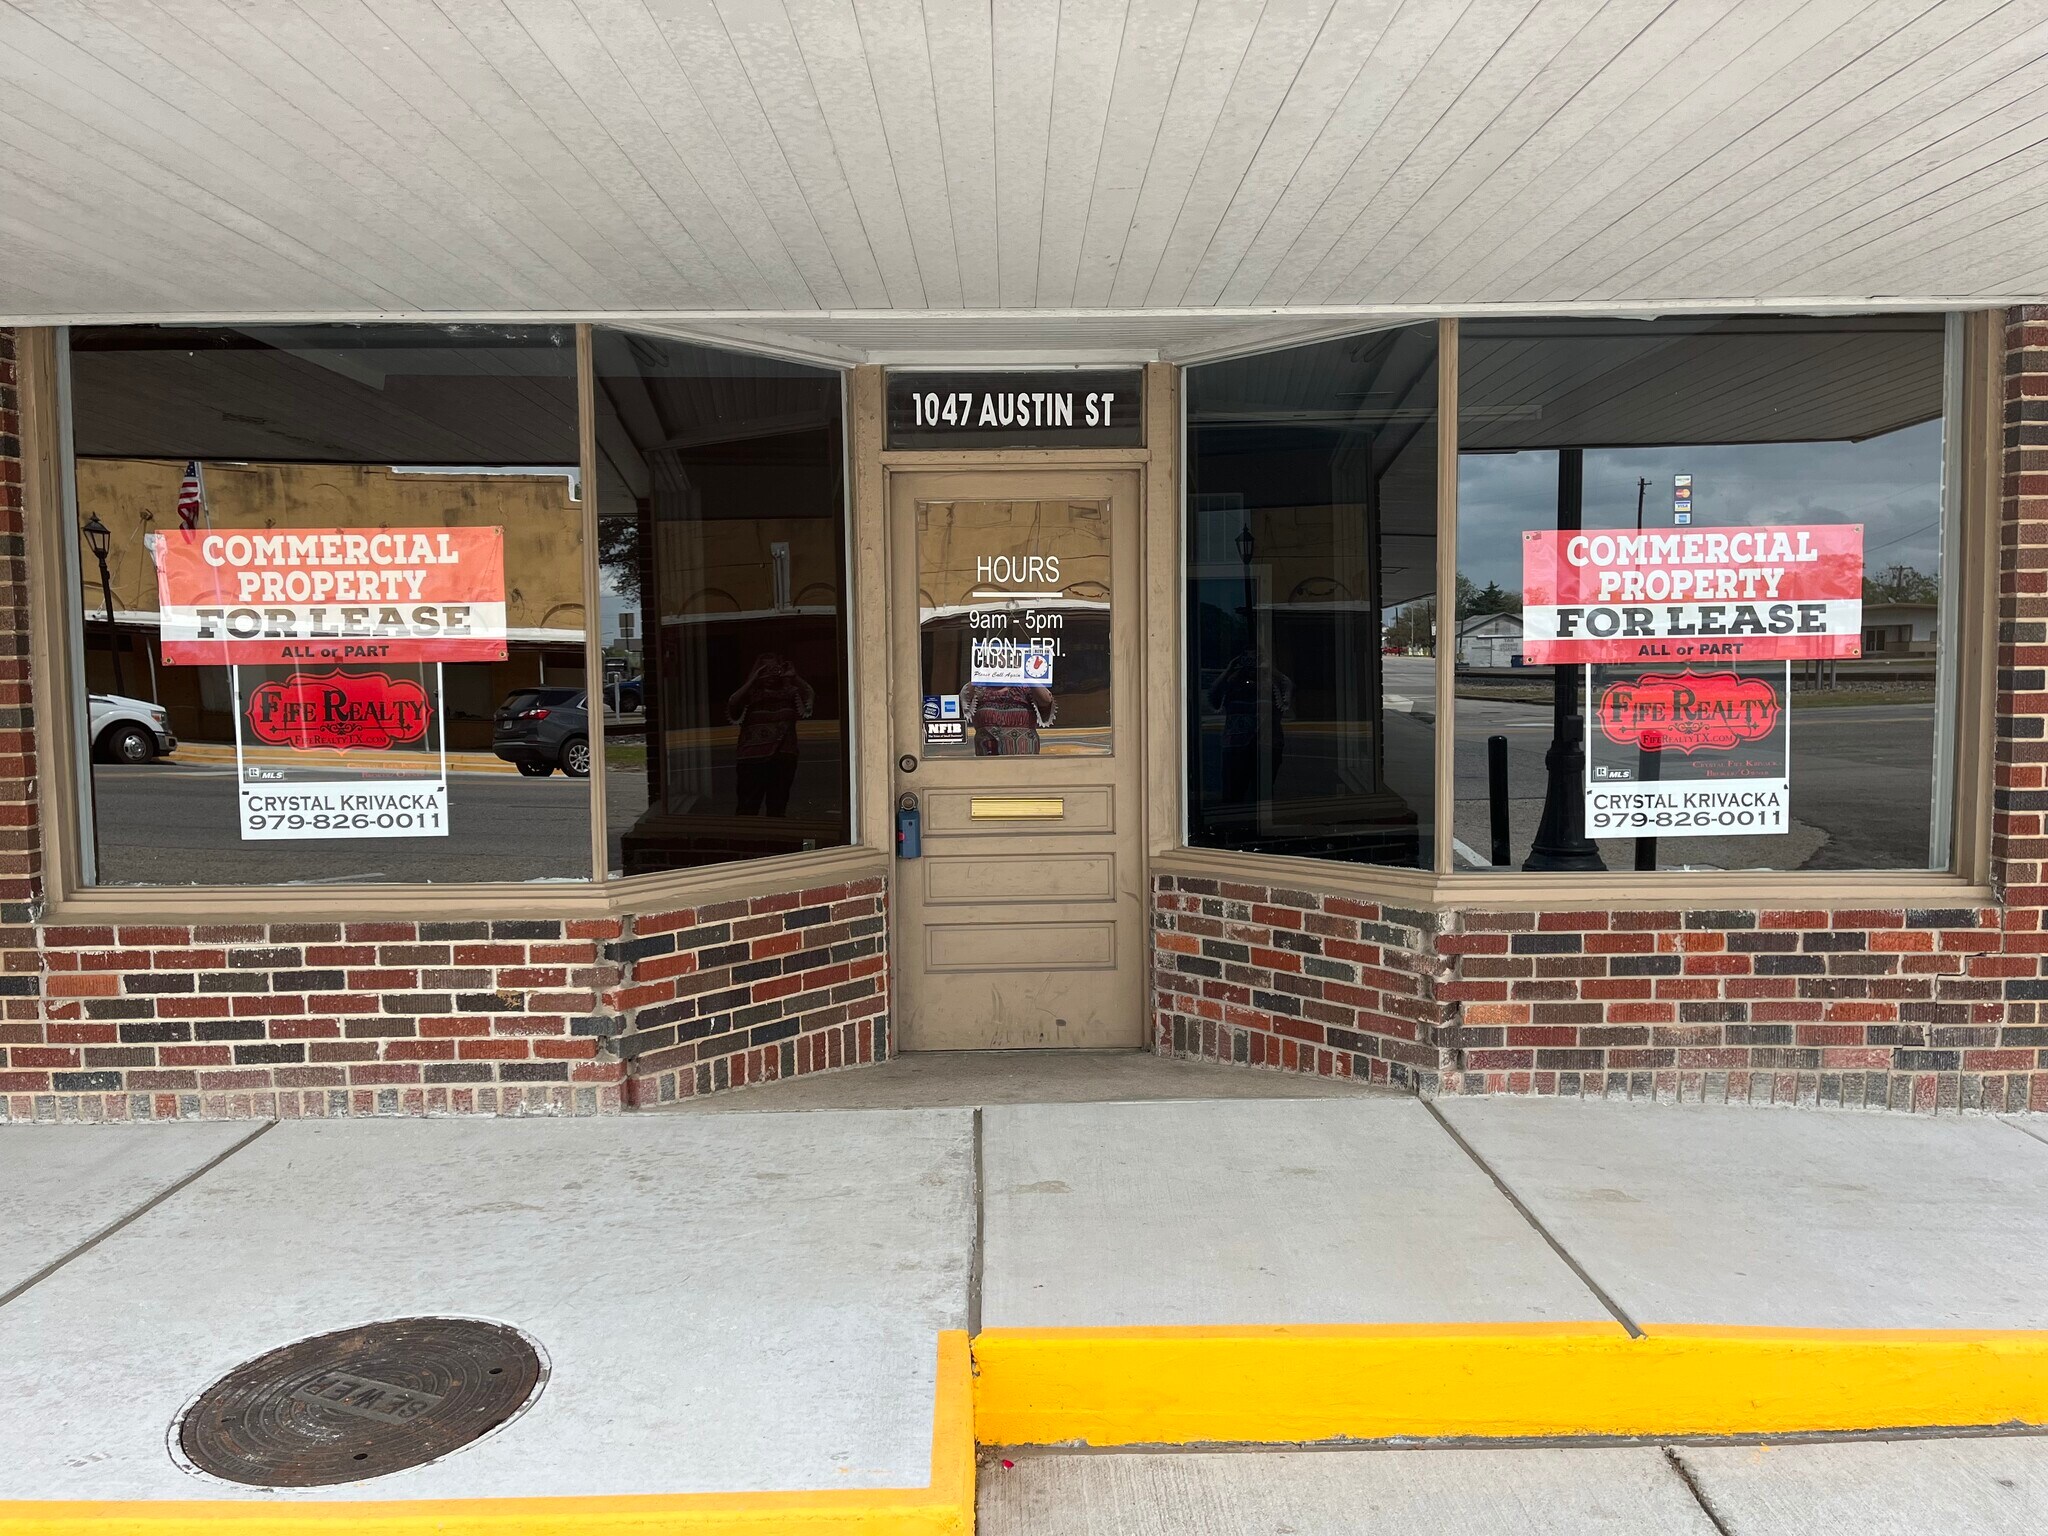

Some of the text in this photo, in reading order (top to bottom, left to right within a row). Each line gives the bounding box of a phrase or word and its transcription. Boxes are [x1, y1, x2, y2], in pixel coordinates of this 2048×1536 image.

[912, 392, 1115, 427] 1047 AUSTIN ST
[202, 533, 459, 567] COMMERCIAL
[1566, 531, 1818, 567] COMMERCIAL
[976, 555, 1060, 583] HOURS
[237, 570, 427, 602] PROPERTY
[1598, 568, 1784, 602] PROPERTY
[196, 605, 472, 639] FOR LEASE
[969, 609, 1007, 629] 9am
[1025, 609, 1063, 634] 5pm
[1556, 603, 1827, 639] FOR LEASE
[281, 644, 390, 659] ALL or PART
[974, 648, 1022, 669] CLOSED
[1030, 637, 1066, 657] FRI.
[1638, 643, 1744, 657] ALL or PART
[928, 723, 962, 734] NFIB
[261, 772, 284, 780] MLS
[247, 794, 439, 812] CRYSTAL KRIVACKA
[1593, 792, 1781, 810] CRYSTAL KRIVACKA
[248, 813, 441, 831] 979-826-0011
[1593, 811, 1781, 829] 979-826-0011
[303, 1376, 428, 1418] SEWER
